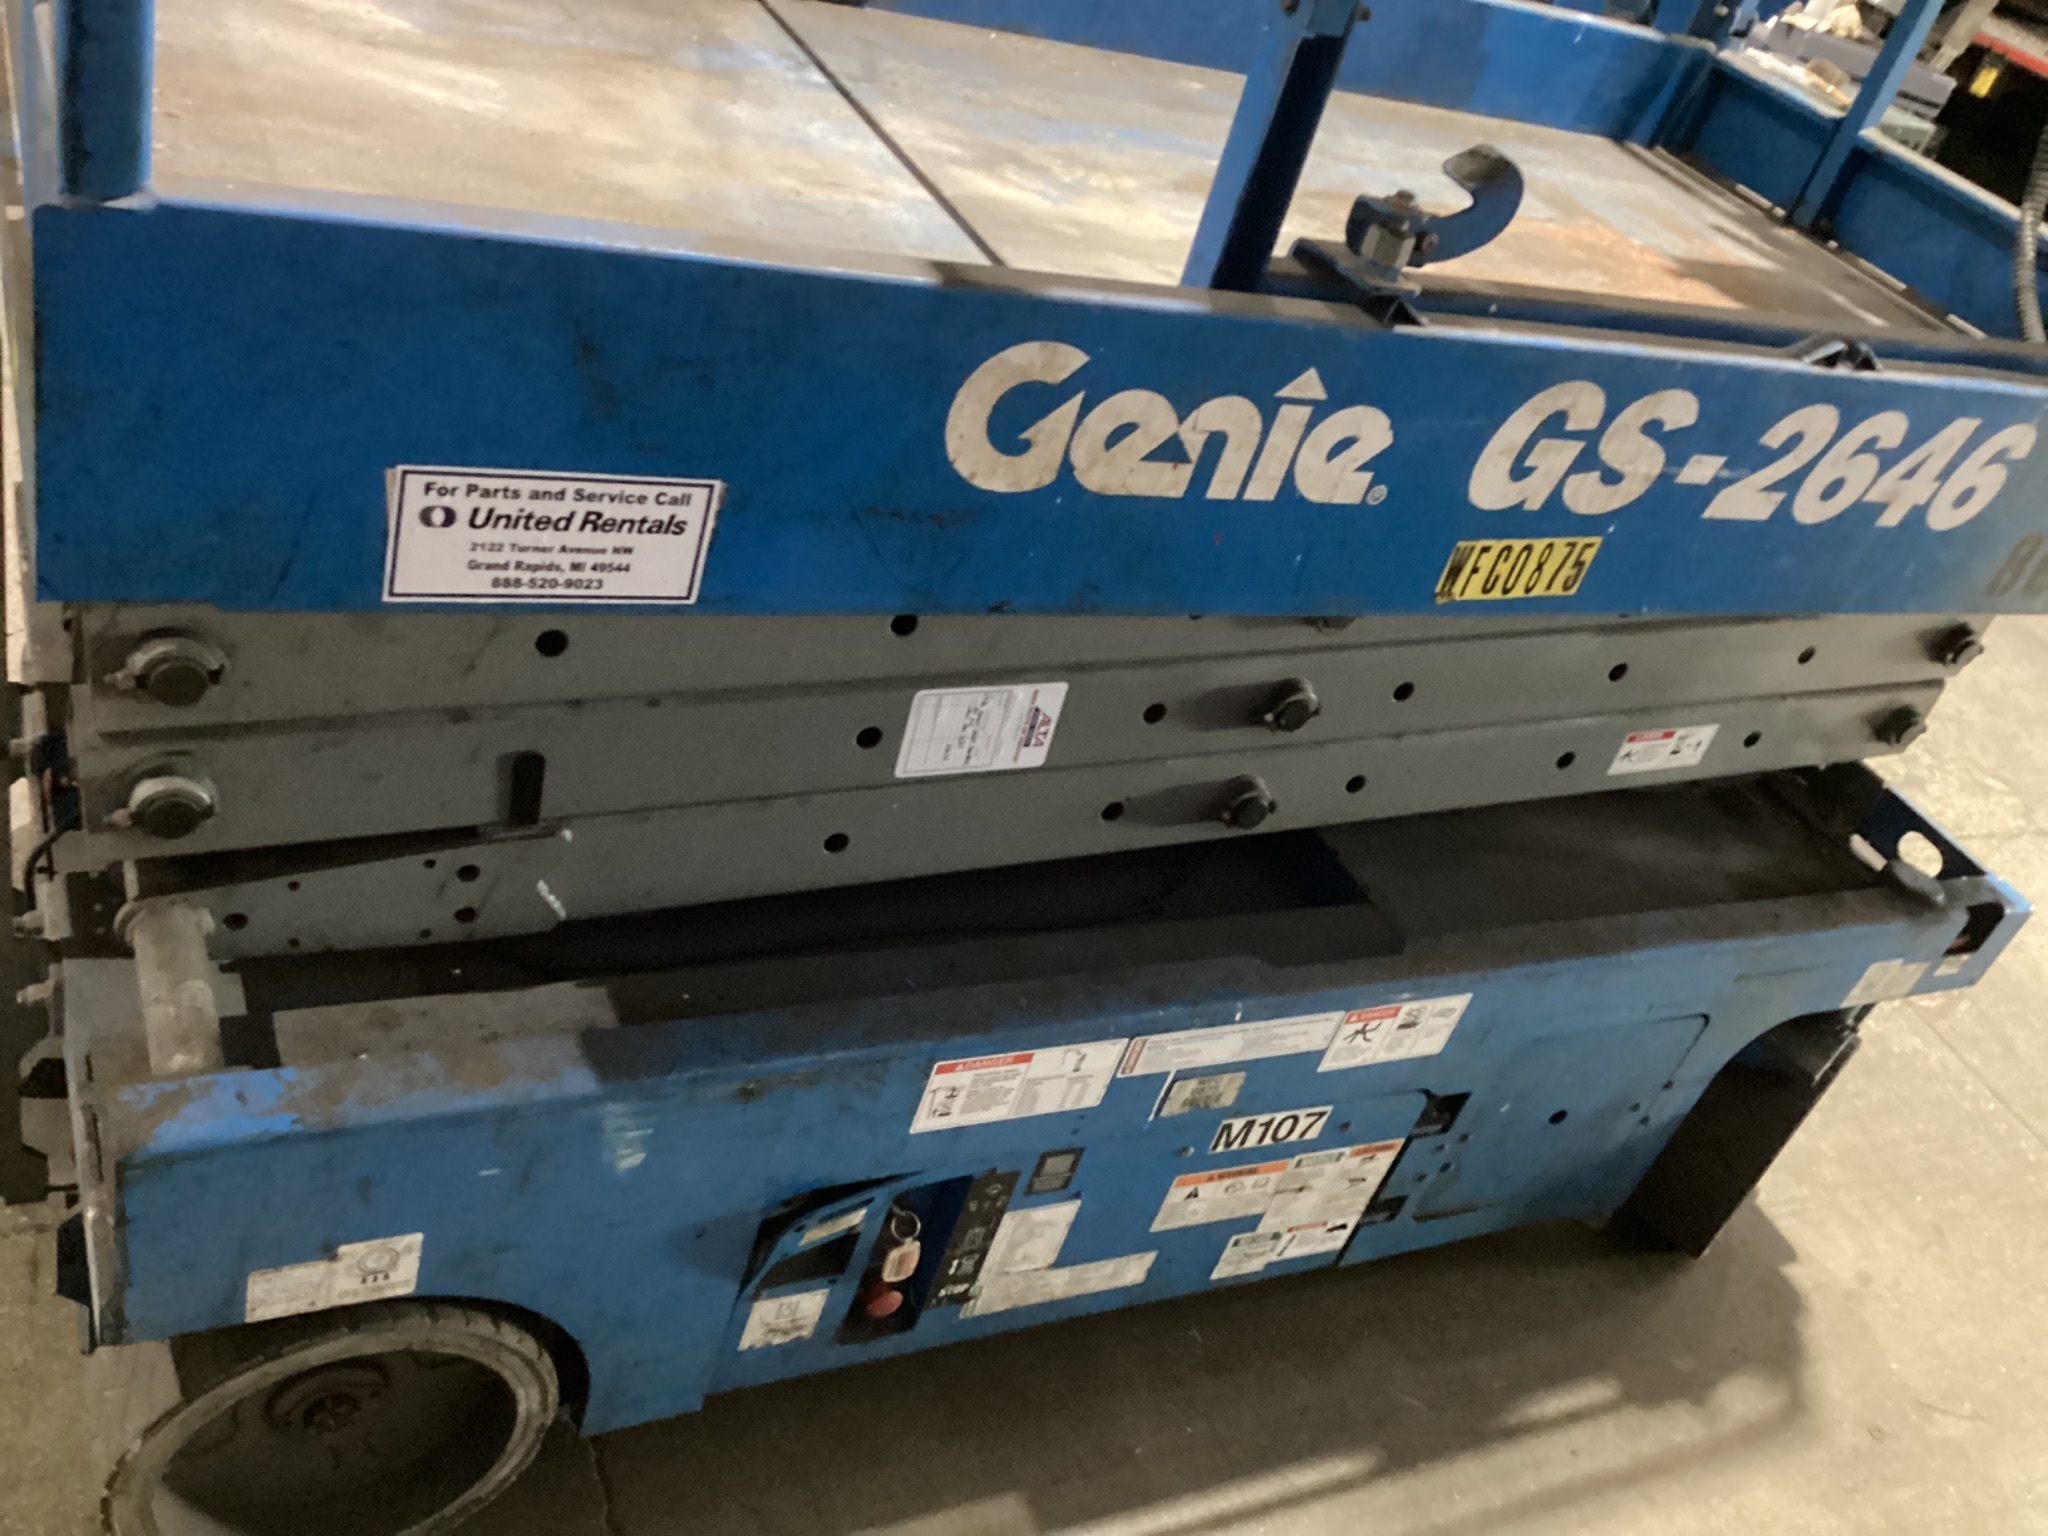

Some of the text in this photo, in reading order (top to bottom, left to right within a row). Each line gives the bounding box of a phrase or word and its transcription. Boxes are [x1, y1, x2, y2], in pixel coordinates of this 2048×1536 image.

[1467, 381, 2037, 532] GS-2646
[424, 481, 692, 506] For Parts and Service Call
[468, 506, 688, 536] United Rentals
[558, 545, 608, 554] Avenue
[467, 559, 631, 574] Grand Rapids, MI 49544
[491, 577, 604, 590] 888-520-9023
[965, 1056, 1015, 1071] DANGER
[1211, 1111, 1329, 1150] M107
